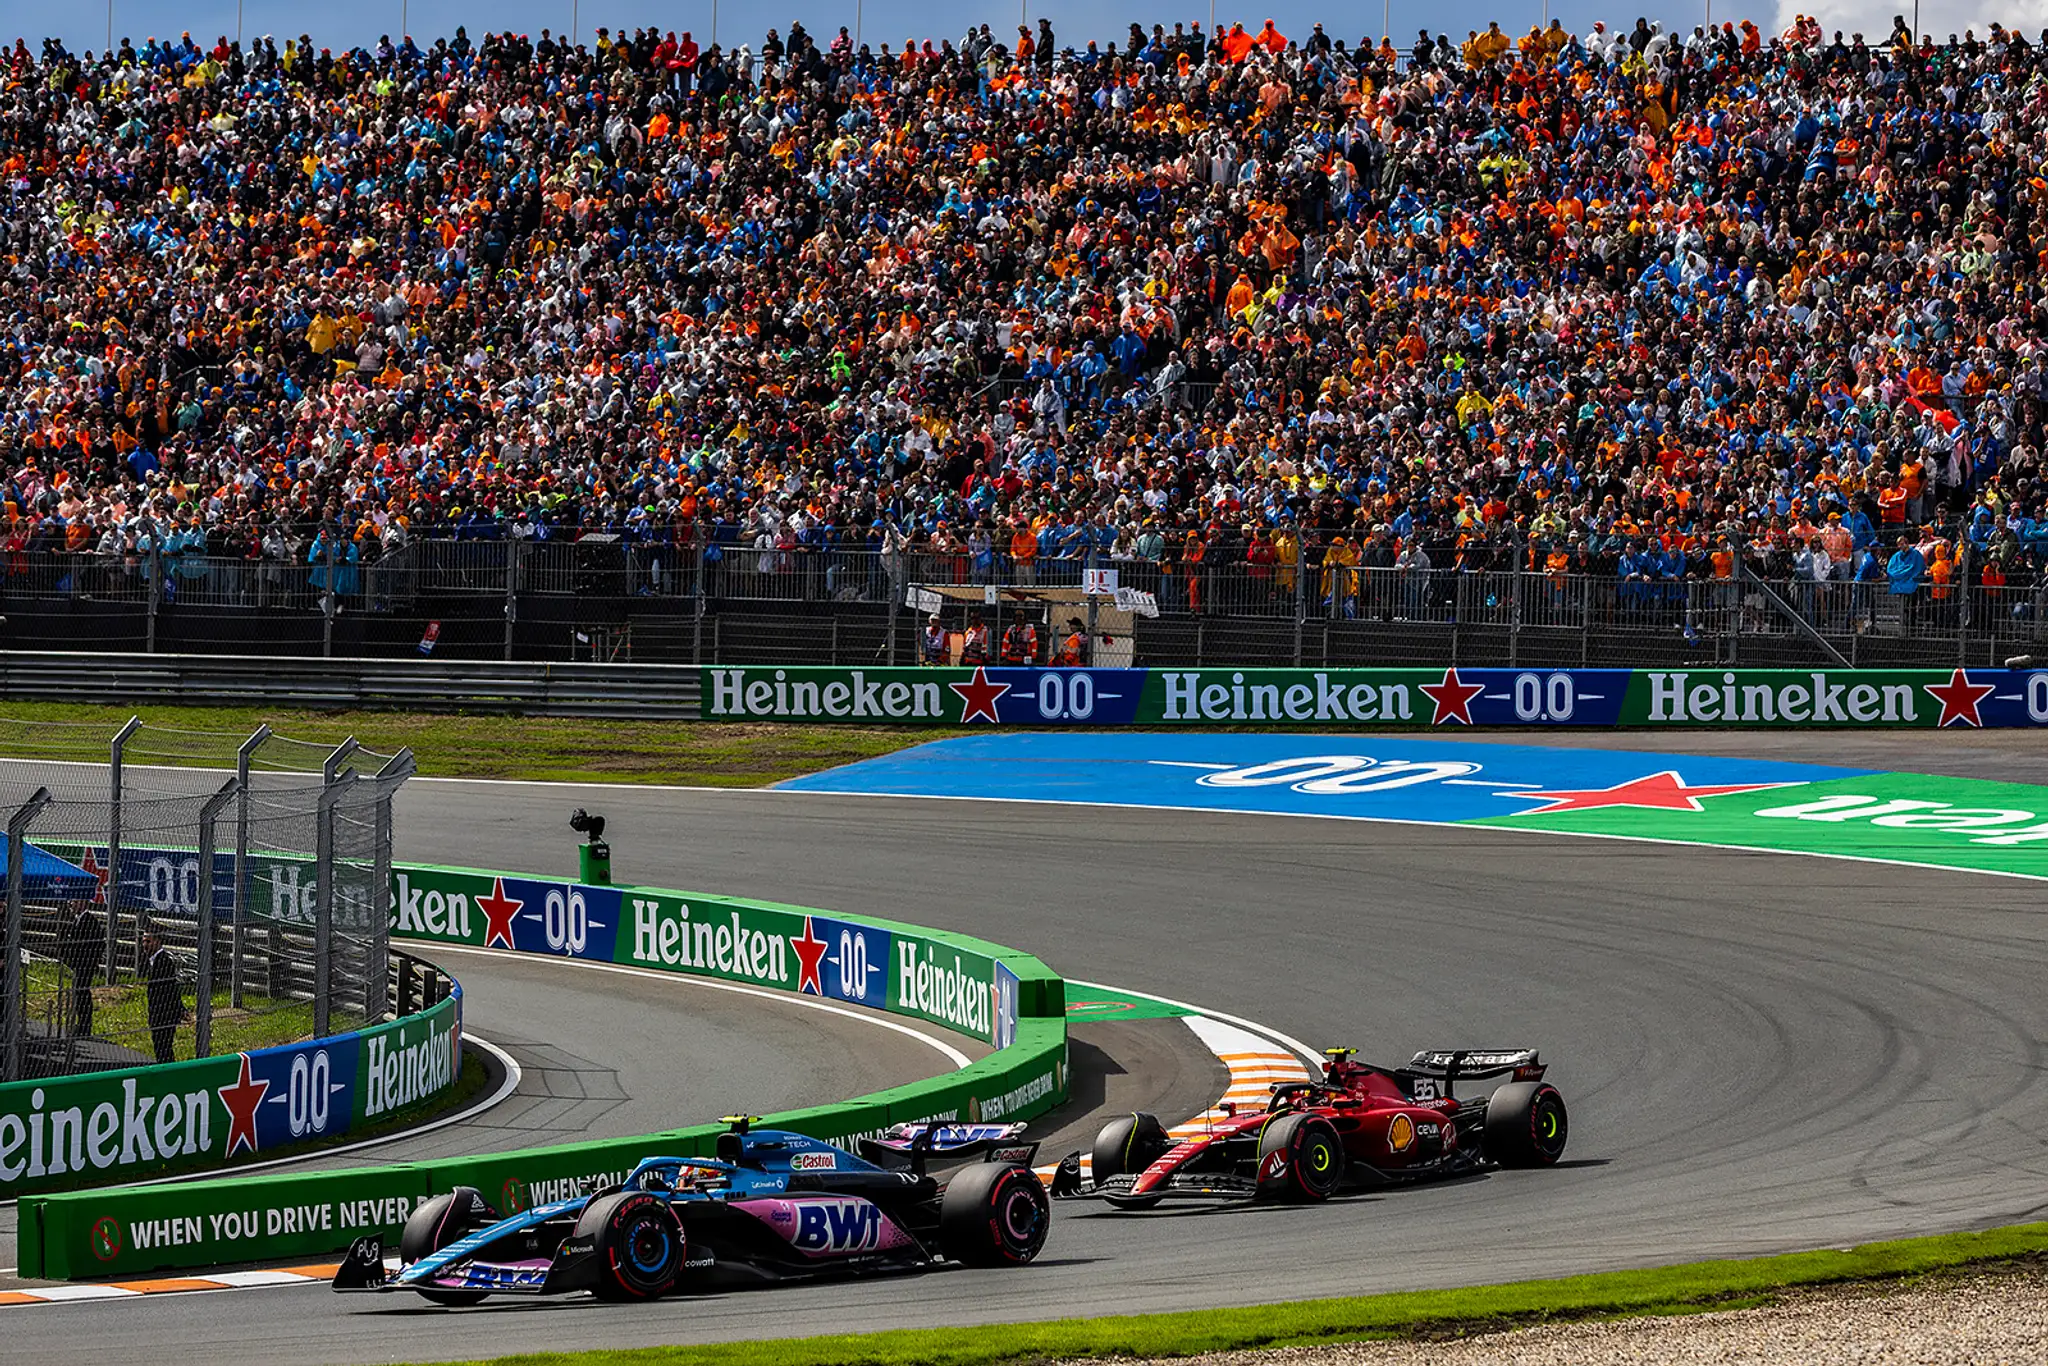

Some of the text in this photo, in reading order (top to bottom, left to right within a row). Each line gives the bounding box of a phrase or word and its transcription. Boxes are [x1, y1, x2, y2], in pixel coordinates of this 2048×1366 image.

[711, 669, 1095, 719] Heineken 0.0
[1162, 672, 1575, 721] Heineken 0.0
[1648, 673, 1918, 722] Heineken
[271, 864, 586, 953] Henken 0.0
[632, 900, 867, 999] Heineken 0.0
[898, 941, 990, 1034] Heineken
[365, 1019, 450, 1117] Heineken
[1414, 1077, 1434, 1100] 55
[289, 1049, 329, 1138] 0.0
[803, 1155, 834, 1168] Castrol
[530, 1177, 580, 1206] WHEN
[130, 1216, 202, 1249] WHEN
[209, 1211, 258, 1241] YOU
[267, 1204, 331, 1235] DRIVE
[340, 1197, 409, 1228] NEVER
[794, 1201, 883, 1252] BWT
[571, 1245, 594, 1253] Microsoft
